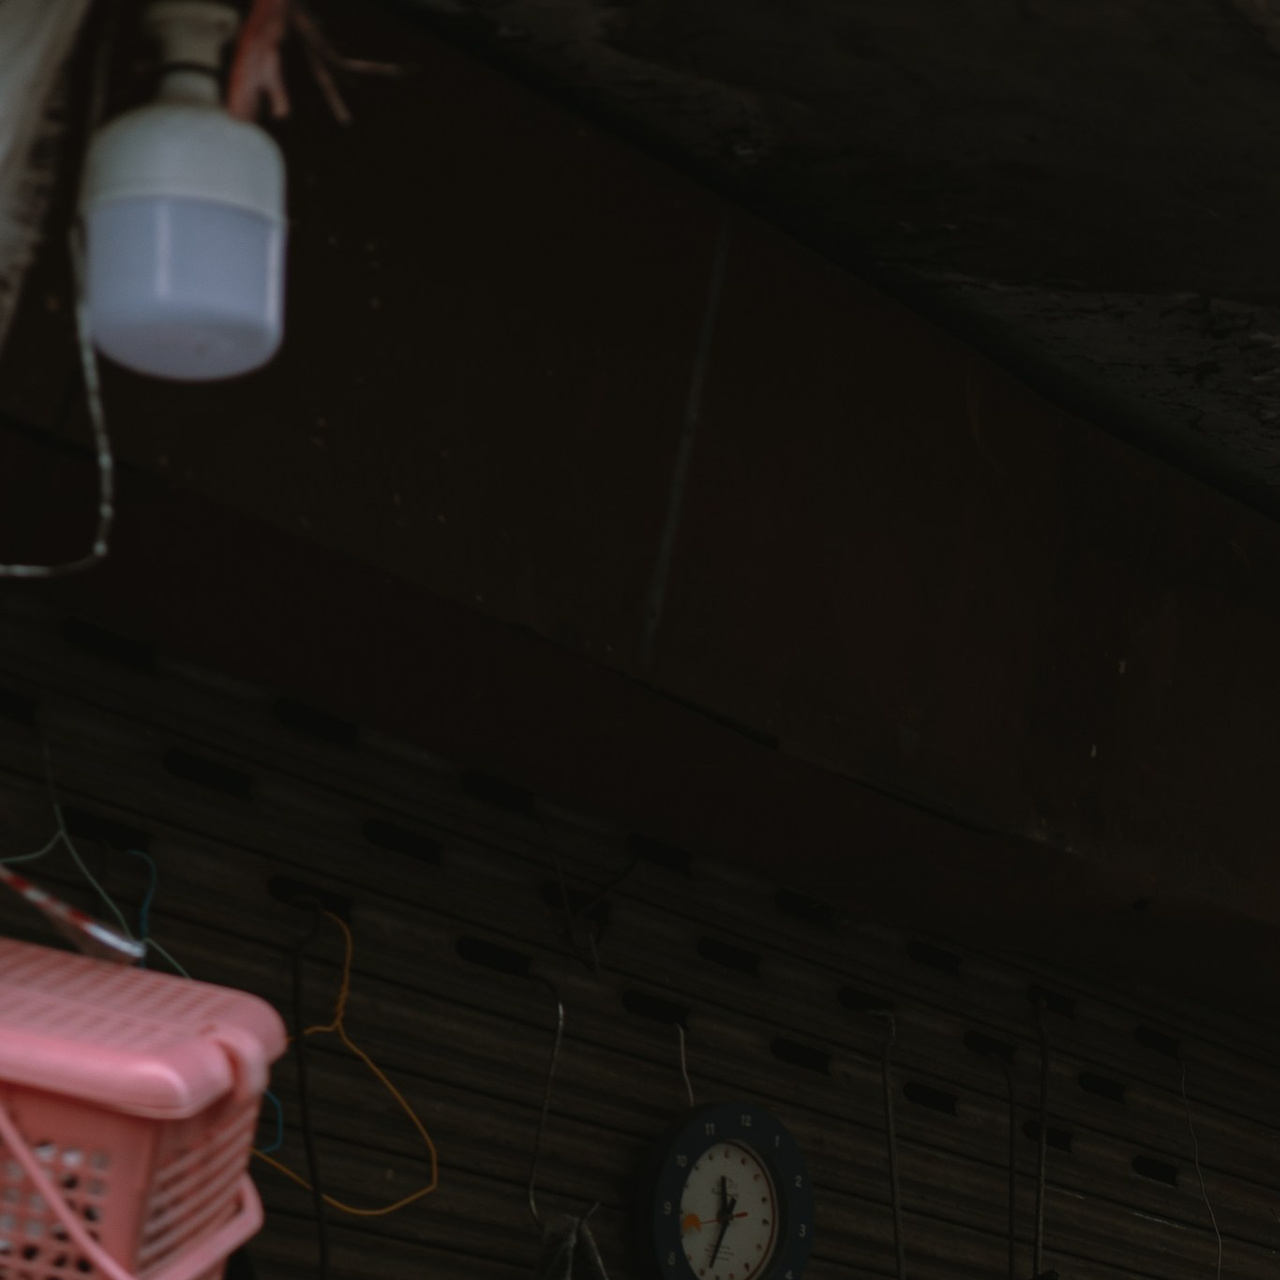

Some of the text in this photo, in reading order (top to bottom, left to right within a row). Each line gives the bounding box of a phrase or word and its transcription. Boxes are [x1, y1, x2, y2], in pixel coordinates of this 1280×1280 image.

[740, 1115, 752, 1128] 12
[705, 1122, 716, 1136] 11
[774, 1135, 780, 1148] 1
[676, 1154, 688, 1168] 10
[795, 1175, 803, 1189] 2
[663, 1202, 672, 1215] 9
[799, 1224, 807, 1238] 3
[667, 1252, 676, 1266] 8
